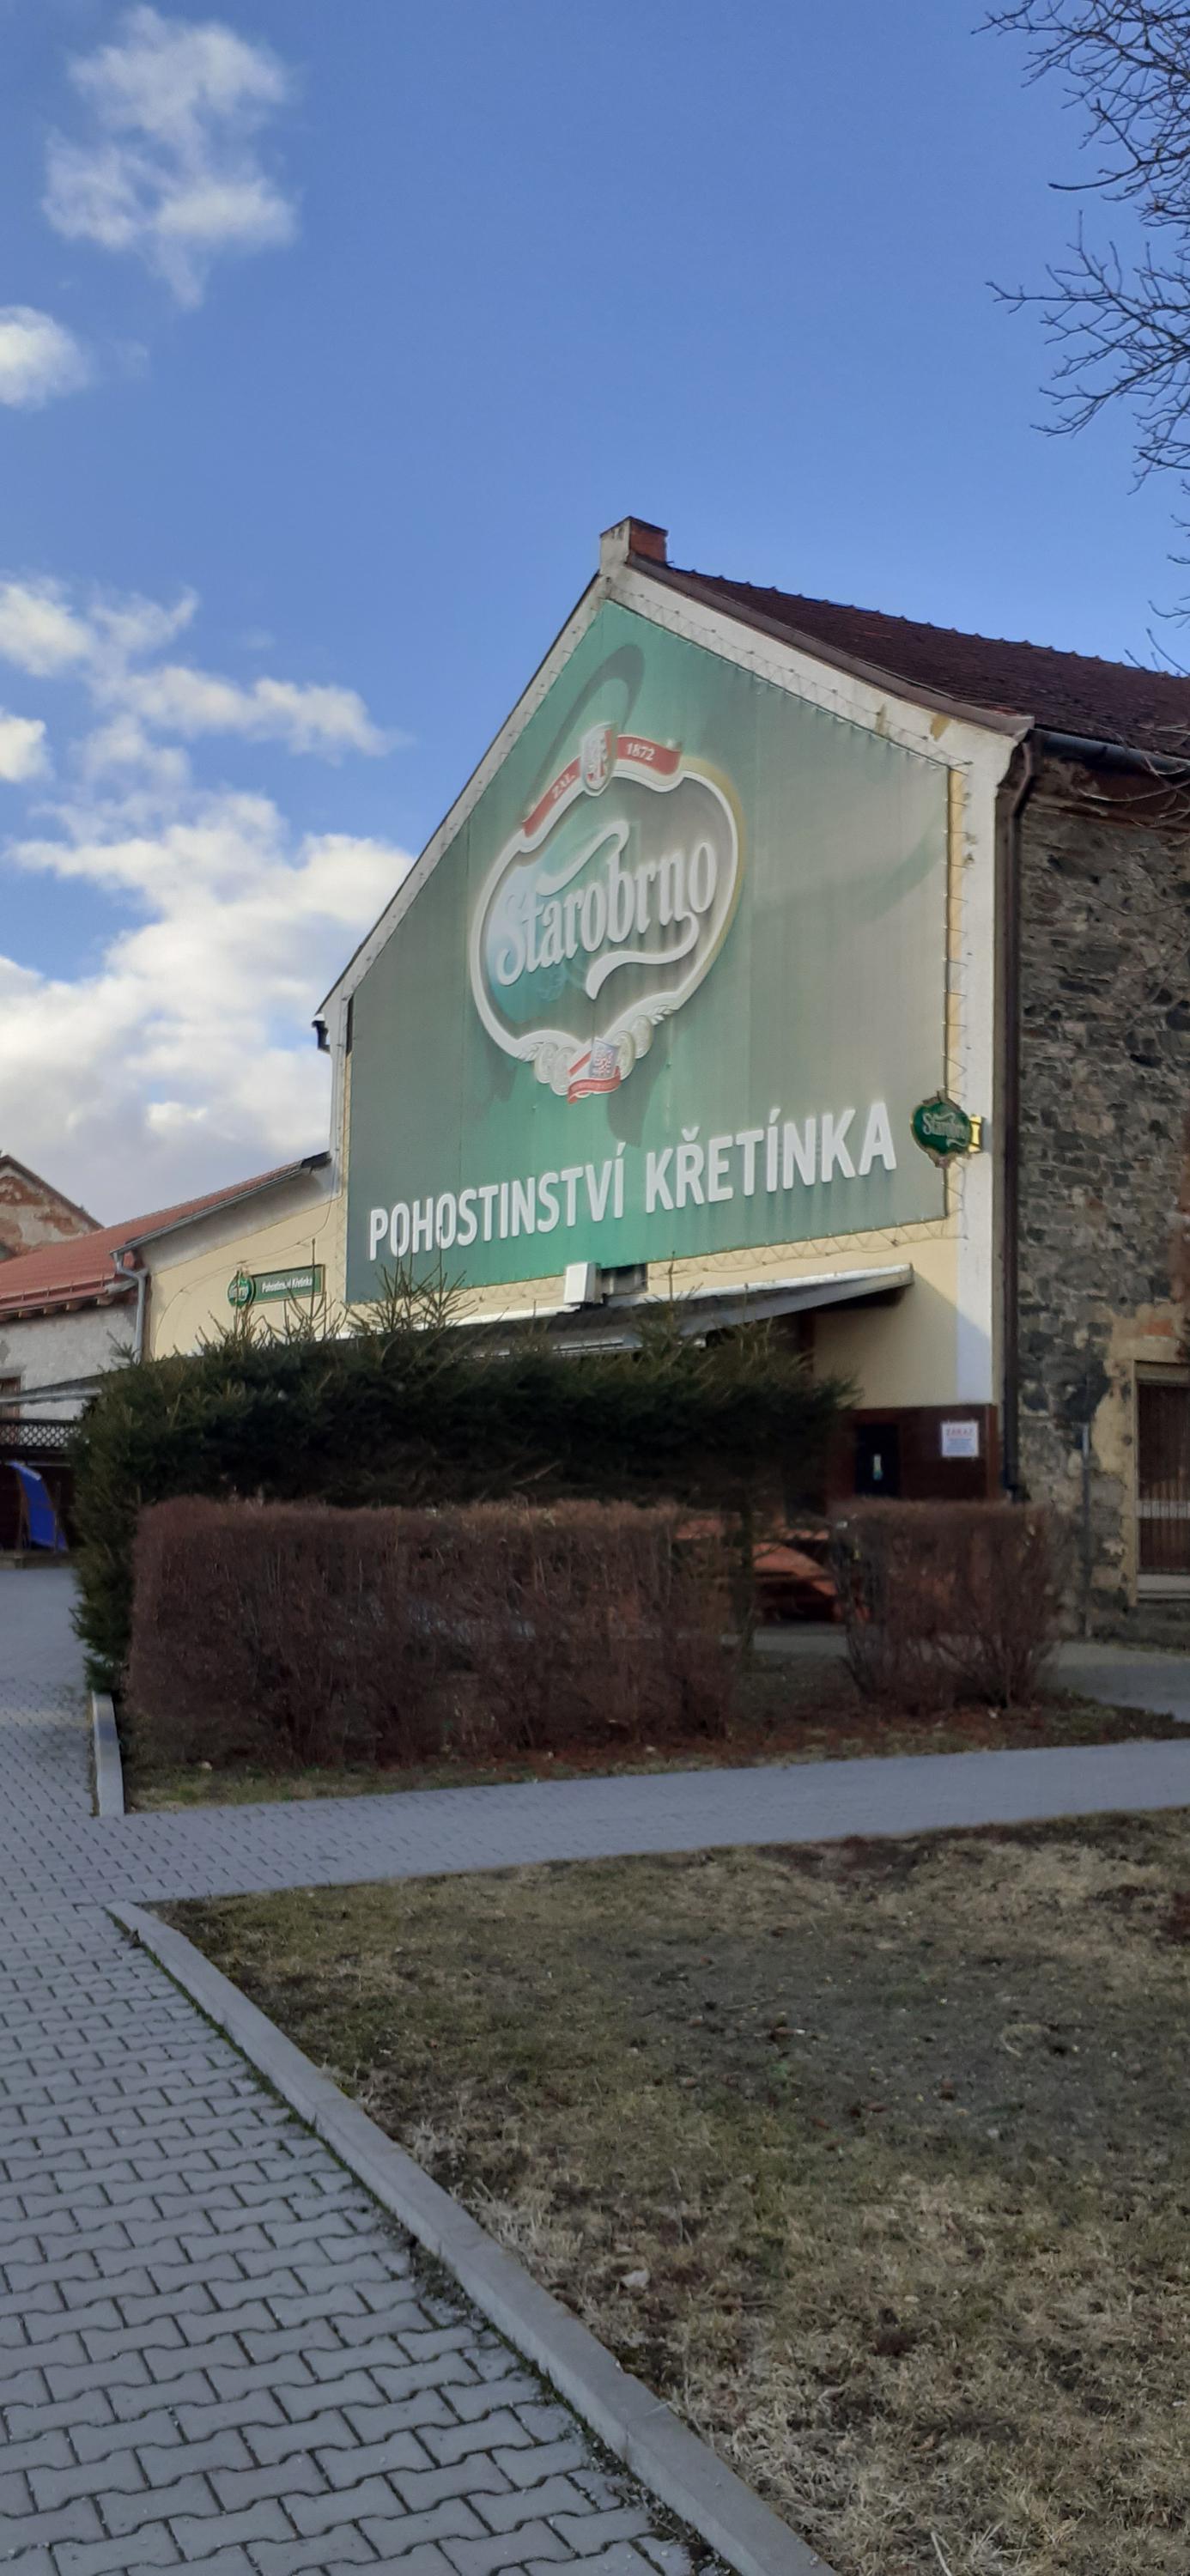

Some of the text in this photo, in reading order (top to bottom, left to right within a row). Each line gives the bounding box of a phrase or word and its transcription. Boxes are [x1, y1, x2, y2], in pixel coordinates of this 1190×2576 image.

[626, 742, 656, 762] 1872
[495, 821, 718, 1000] Starobrno
[368, 1102, 897, 1261] POHOSTINSTVÍ KŘETÍNKA
